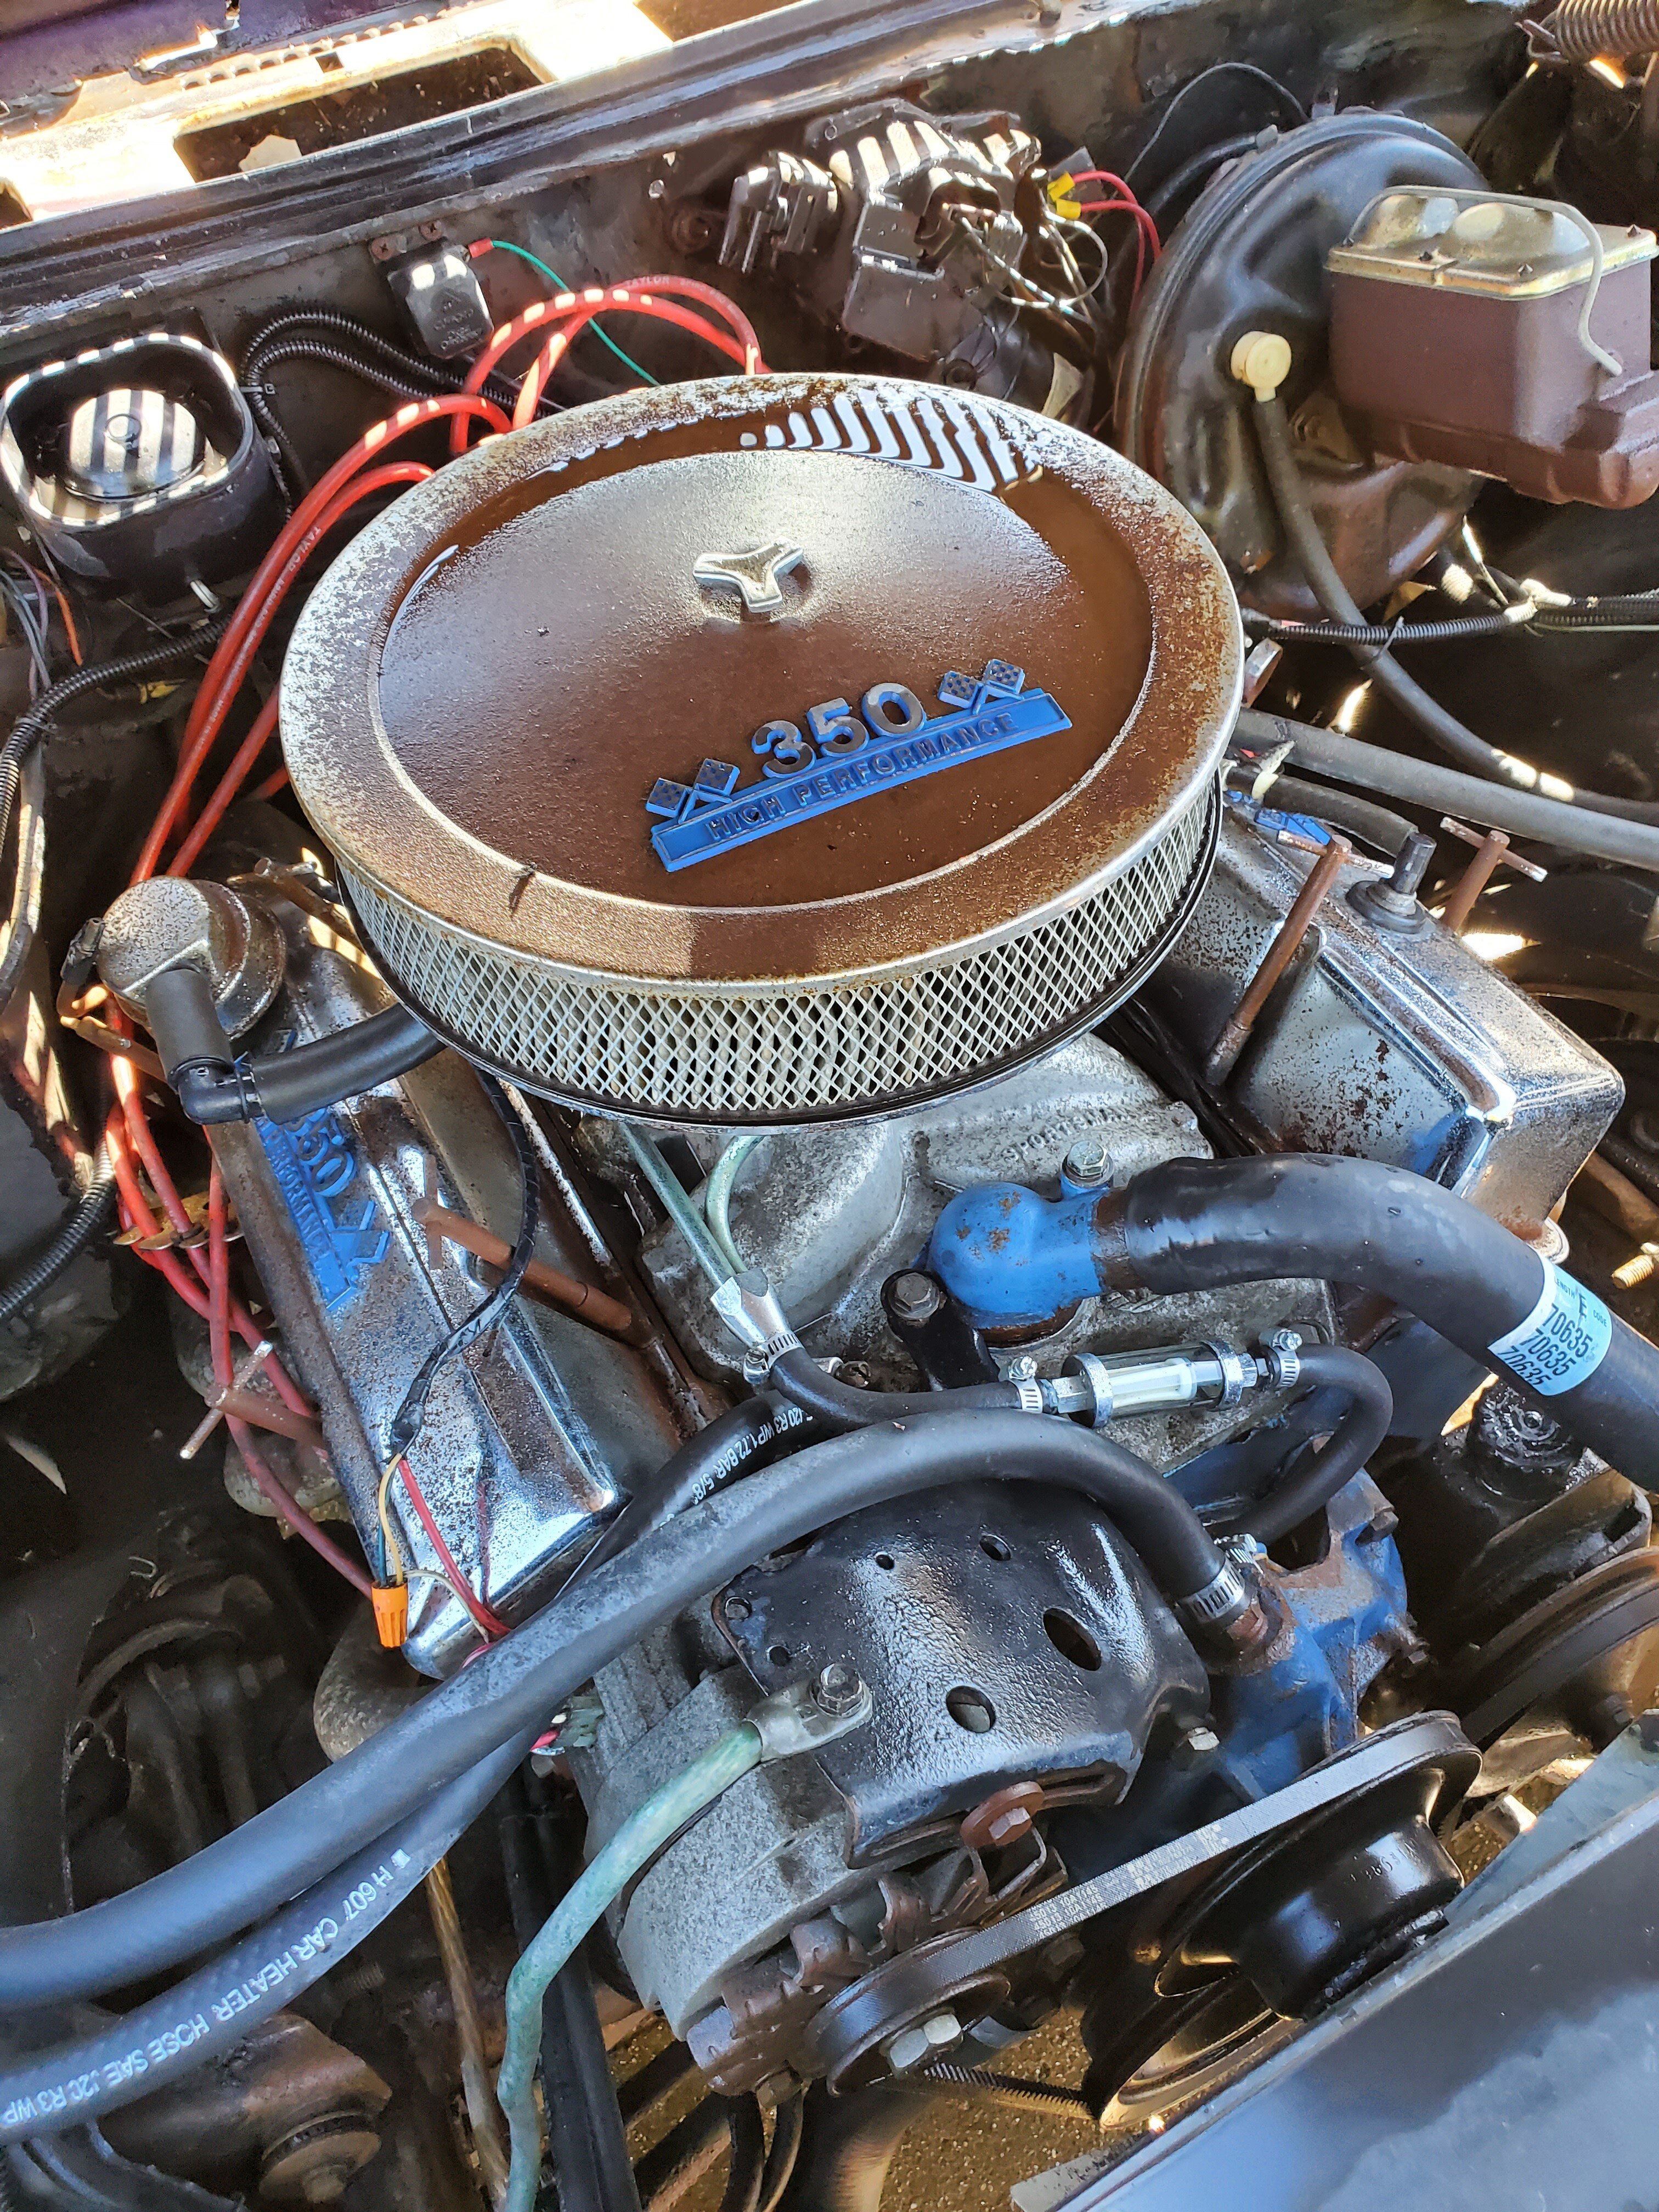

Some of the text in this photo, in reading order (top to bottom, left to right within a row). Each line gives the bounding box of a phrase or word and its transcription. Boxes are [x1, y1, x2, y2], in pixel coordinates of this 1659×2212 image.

[627, 275, 670, 288] TAYLOR
[288, 526, 321, 572] TAYLOR
[752, 682, 927, 778] 350
[705, 712, 1019, 840] HIGH PERFORMANCE
[1543, 1303, 1593, 1358] 70635
[1594, 1310, 1607, 1327] CODE
[1520, 1328, 1577, 1376] 70635
[774, 1415, 789, 1435] R3
[713, 1447, 740, 1480] BAR
[370, 1865, 394, 1888] H
[341, 1882, 379, 1921] 607
[297, 1917, 340, 1961] CAR
[212, 1955, 298, 2022] HEATER
[149, 2015, 210, 2064] HOSE
[104, 2053, 149, 2086] SAE
[34, 2089, 65, 2114] R3
